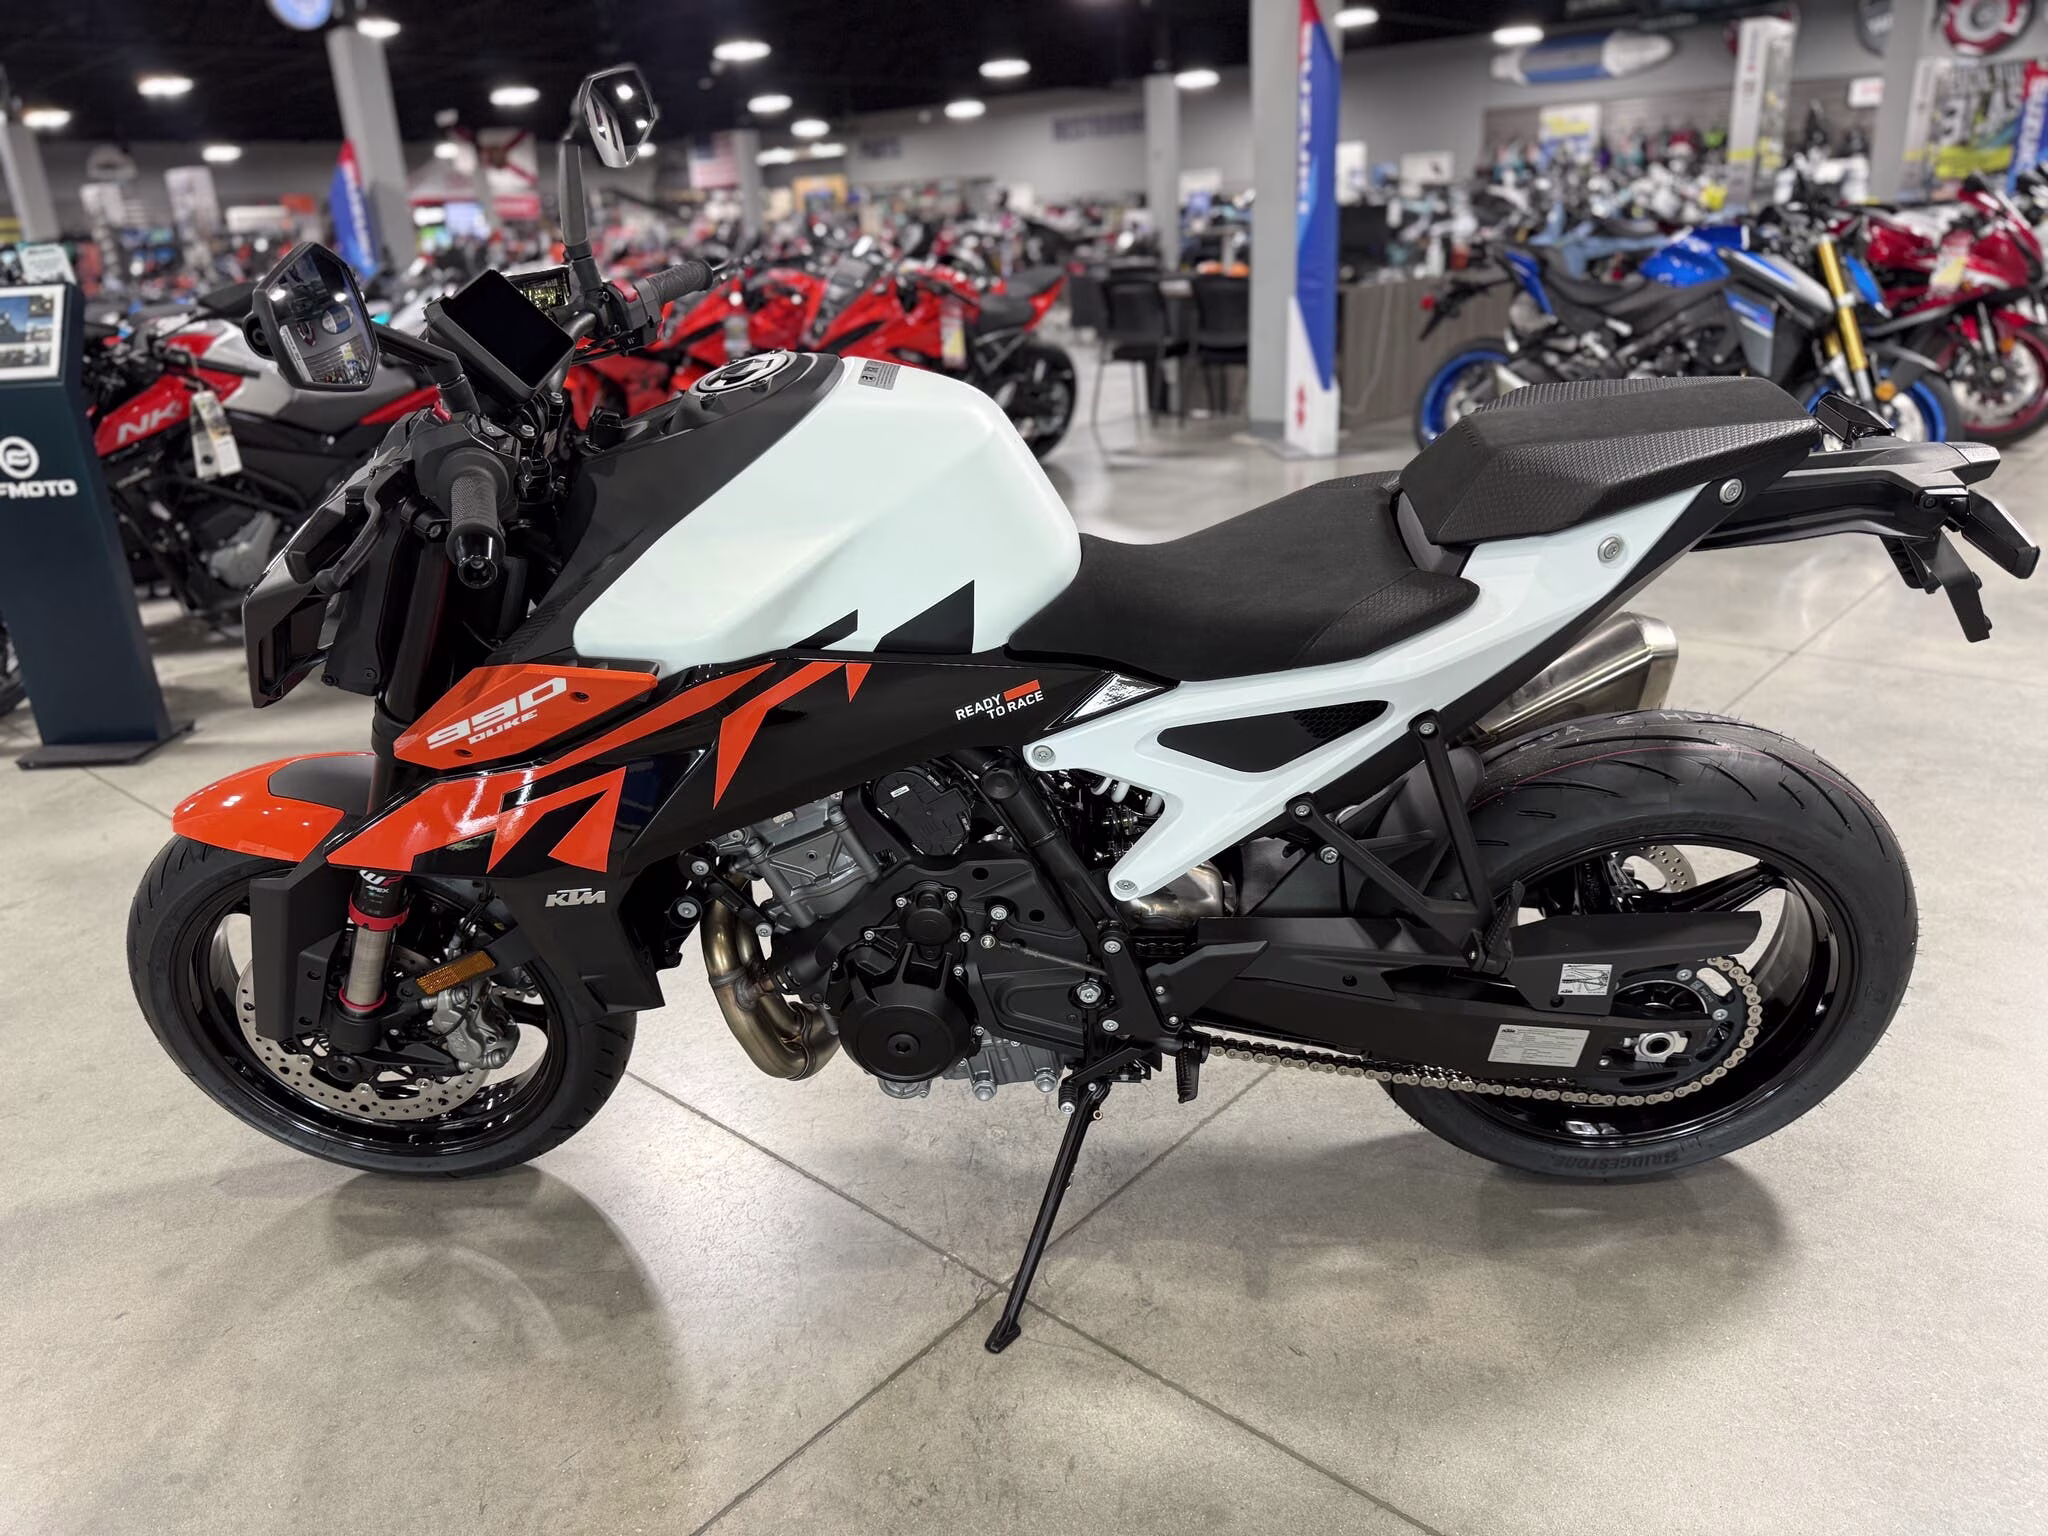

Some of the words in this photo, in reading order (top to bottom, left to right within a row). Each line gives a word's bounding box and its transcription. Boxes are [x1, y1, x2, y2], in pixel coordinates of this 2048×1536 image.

[427, 677, 567, 750] 990
[955, 693, 1001, 721] READY
[986, 705, 1006, 720] TO
[1006, 690, 1044, 713] RACE
[468, 709, 538, 745] DUKE
[545, 887, 606, 907] KTM
